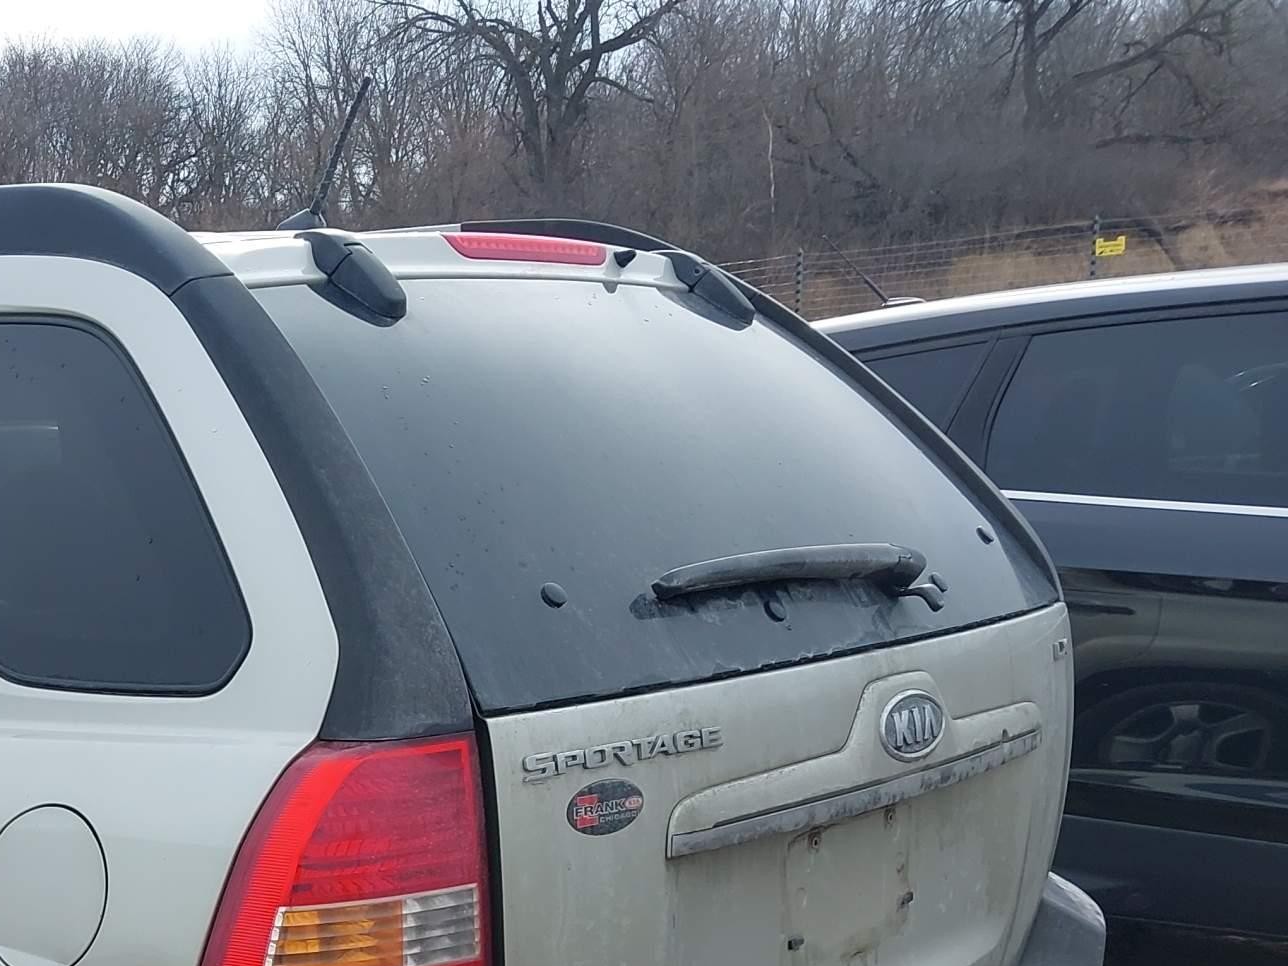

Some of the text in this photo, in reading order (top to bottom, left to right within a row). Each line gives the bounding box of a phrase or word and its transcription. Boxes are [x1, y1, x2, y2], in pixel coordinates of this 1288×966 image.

[891, 703, 938, 748] KIA
[522, 726, 724, 782] SPORTAGE
[573, 797, 626, 820] FRANK
